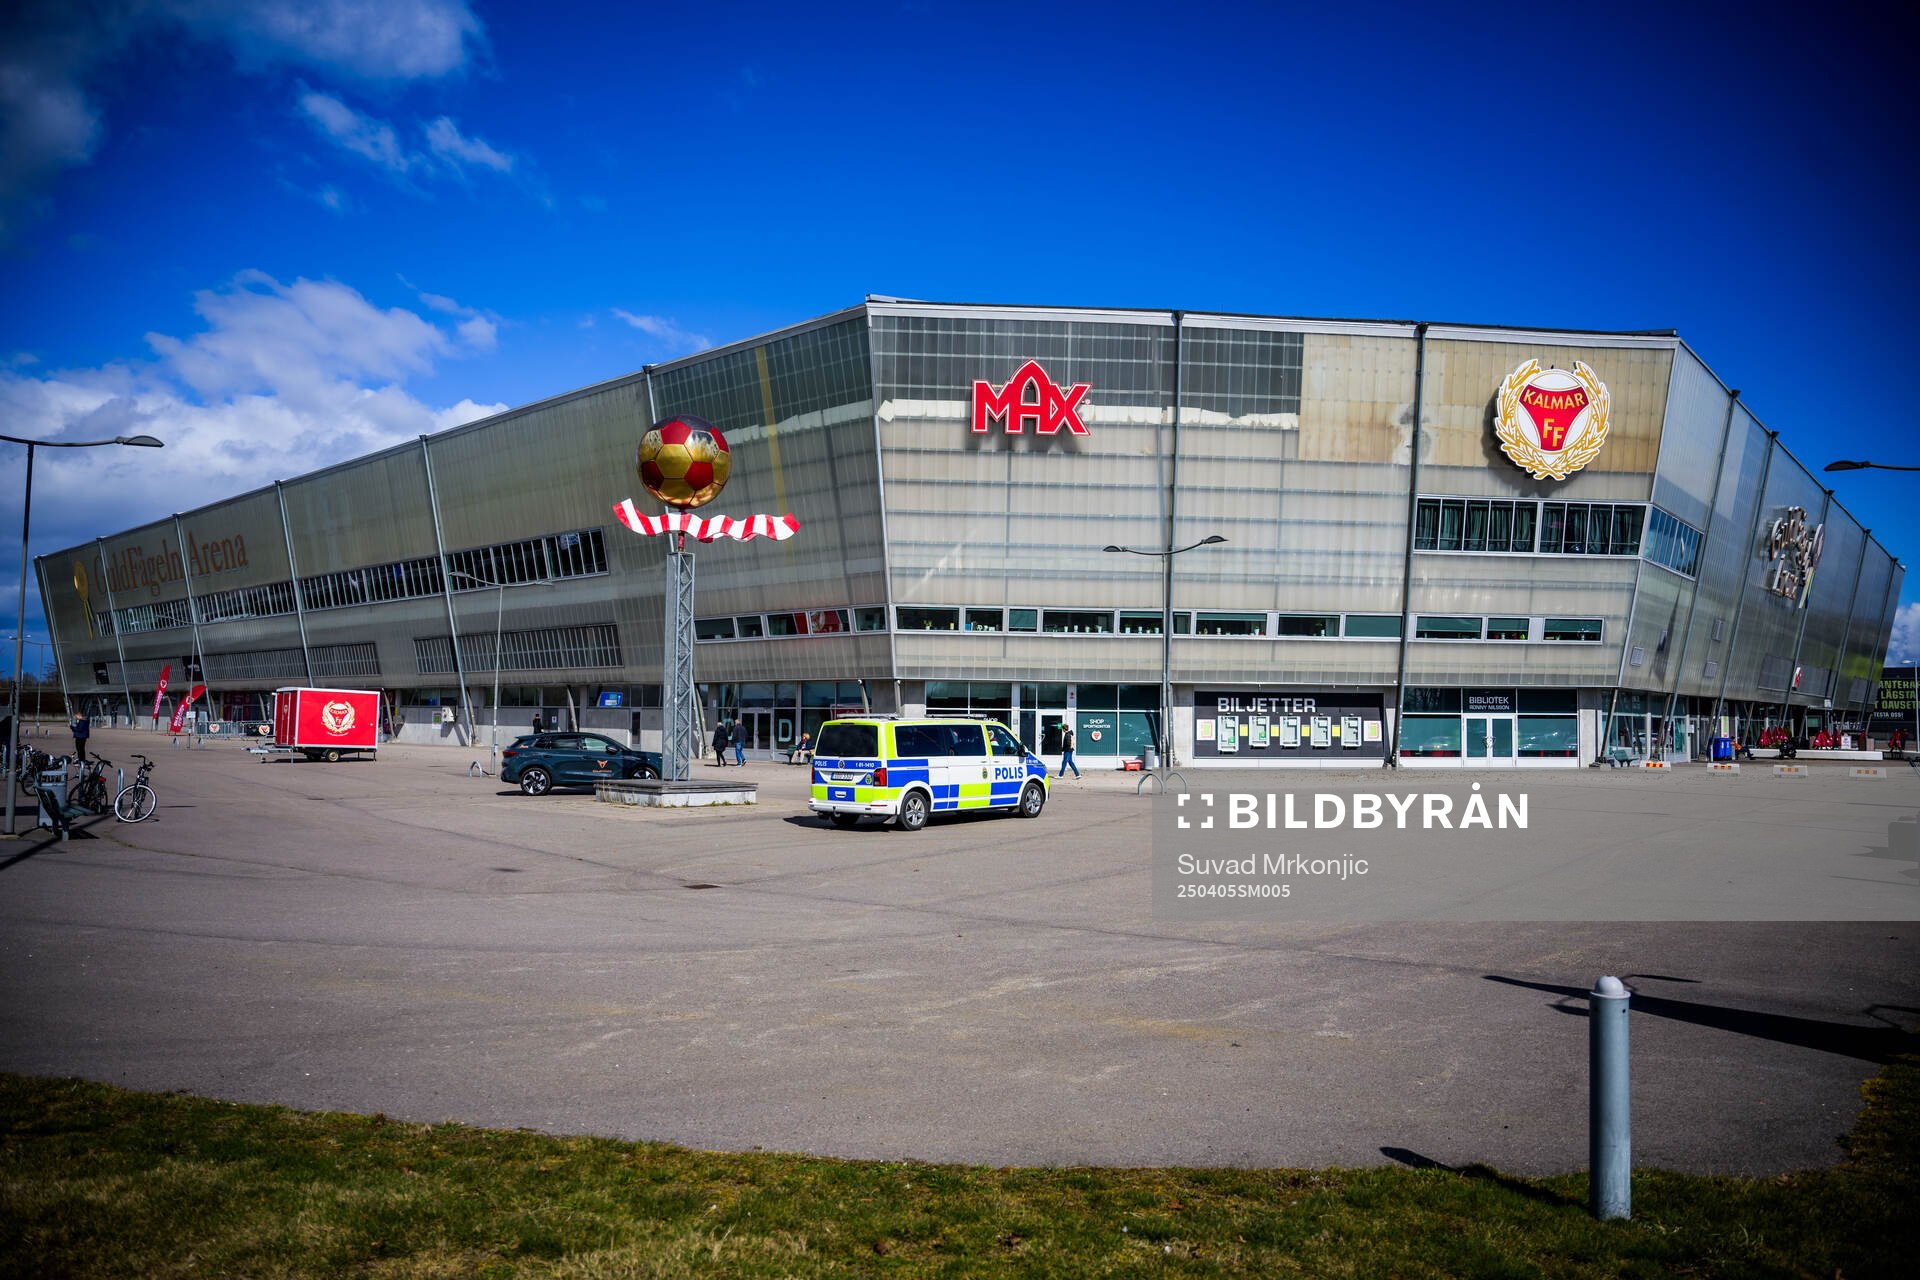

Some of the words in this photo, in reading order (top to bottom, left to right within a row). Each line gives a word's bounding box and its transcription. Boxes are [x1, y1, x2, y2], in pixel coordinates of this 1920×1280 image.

[971, 358, 1092, 436] MAX
[1523, 389, 1585, 410] KALMAR
[1543, 418, 1564, 447] FF
[188, 531, 248, 577] Arena
[1468, 696, 1509, 704] BIBLIOTEK
[1880, 689, 1916, 699] LÄGSTA
[1217, 697, 1316, 713] BILJETTER
[778, 718, 793, 743] D
[994, 766, 1024, 780] POLIS
